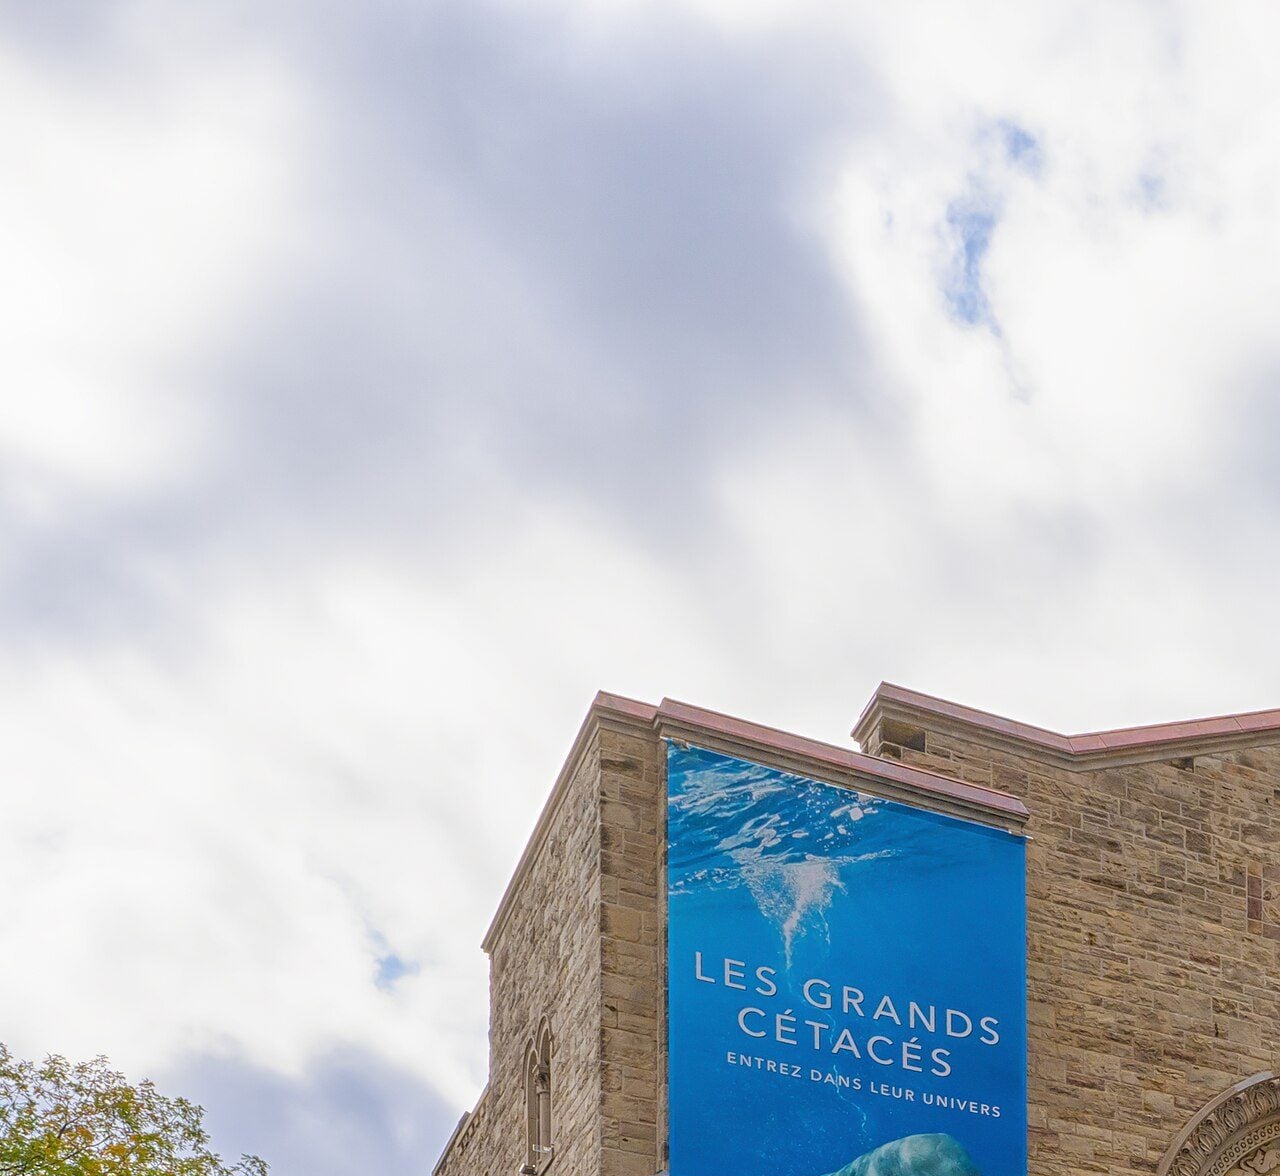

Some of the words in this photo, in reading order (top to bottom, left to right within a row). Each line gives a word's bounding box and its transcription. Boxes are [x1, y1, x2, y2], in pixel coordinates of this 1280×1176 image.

[695, 951, 777, 997] LES
[803, 978, 1000, 1045] GRANDS
[738, 1007, 951, 1077] CÉTACÉS
[727, 1051, 801, 1078] ENTREZ
[810, 1069, 862, 1090] DANS
[870, 1081, 914, 1102] LEUR
[923, 1093, 1001, 1118] UNIVERS
